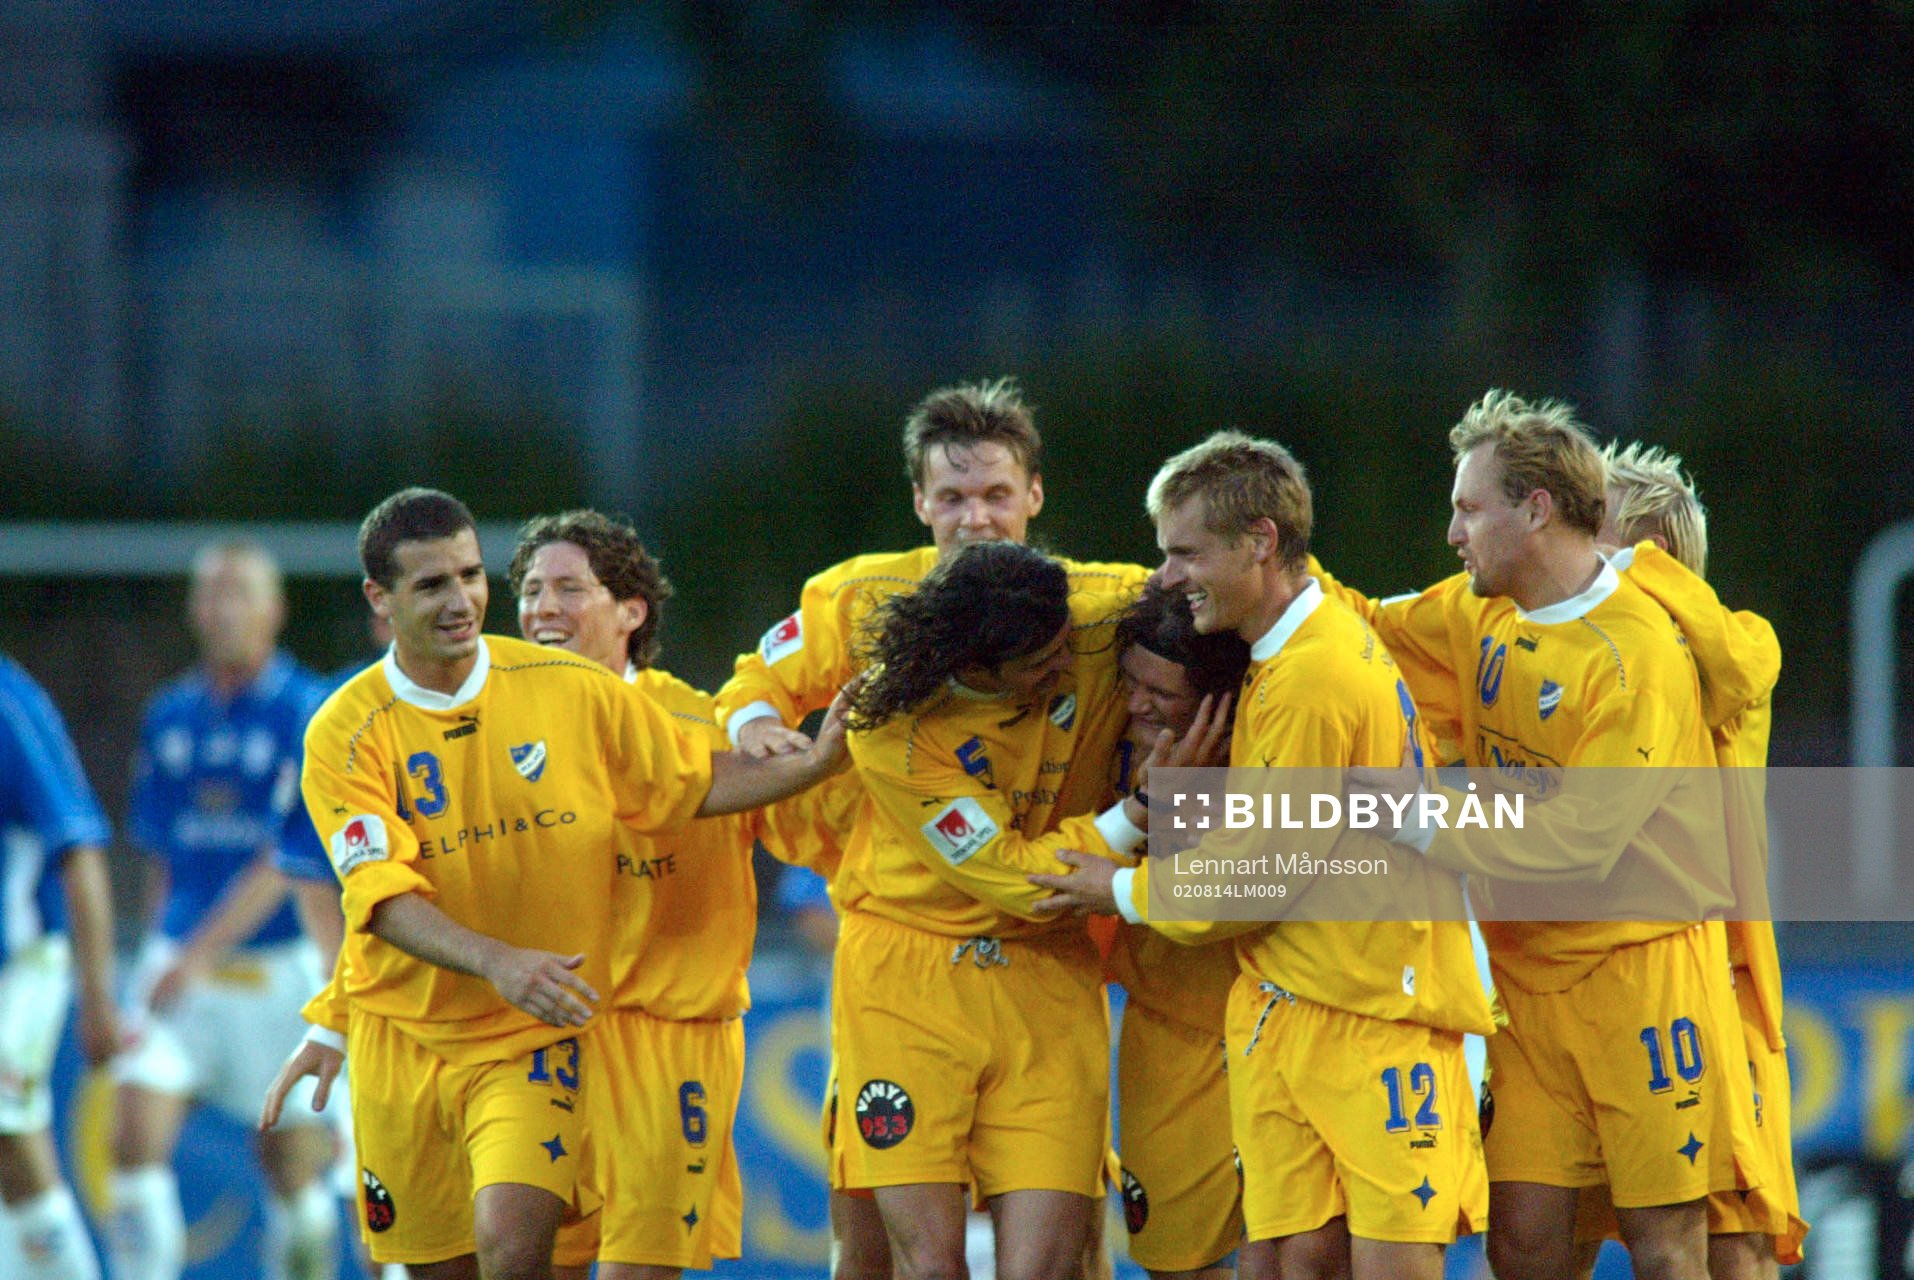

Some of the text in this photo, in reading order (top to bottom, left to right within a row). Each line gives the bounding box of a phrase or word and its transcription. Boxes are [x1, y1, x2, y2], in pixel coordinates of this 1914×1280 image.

[419, 810, 577, 859] ELPHI&Co
[528, 1037, 580, 1095] 13
[1640, 1017, 1707, 1094] 10
[679, 1081, 709, 1149] 6
[856, 1082, 908, 1112] VINYL
[1381, 1063, 1443, 1134] 12
